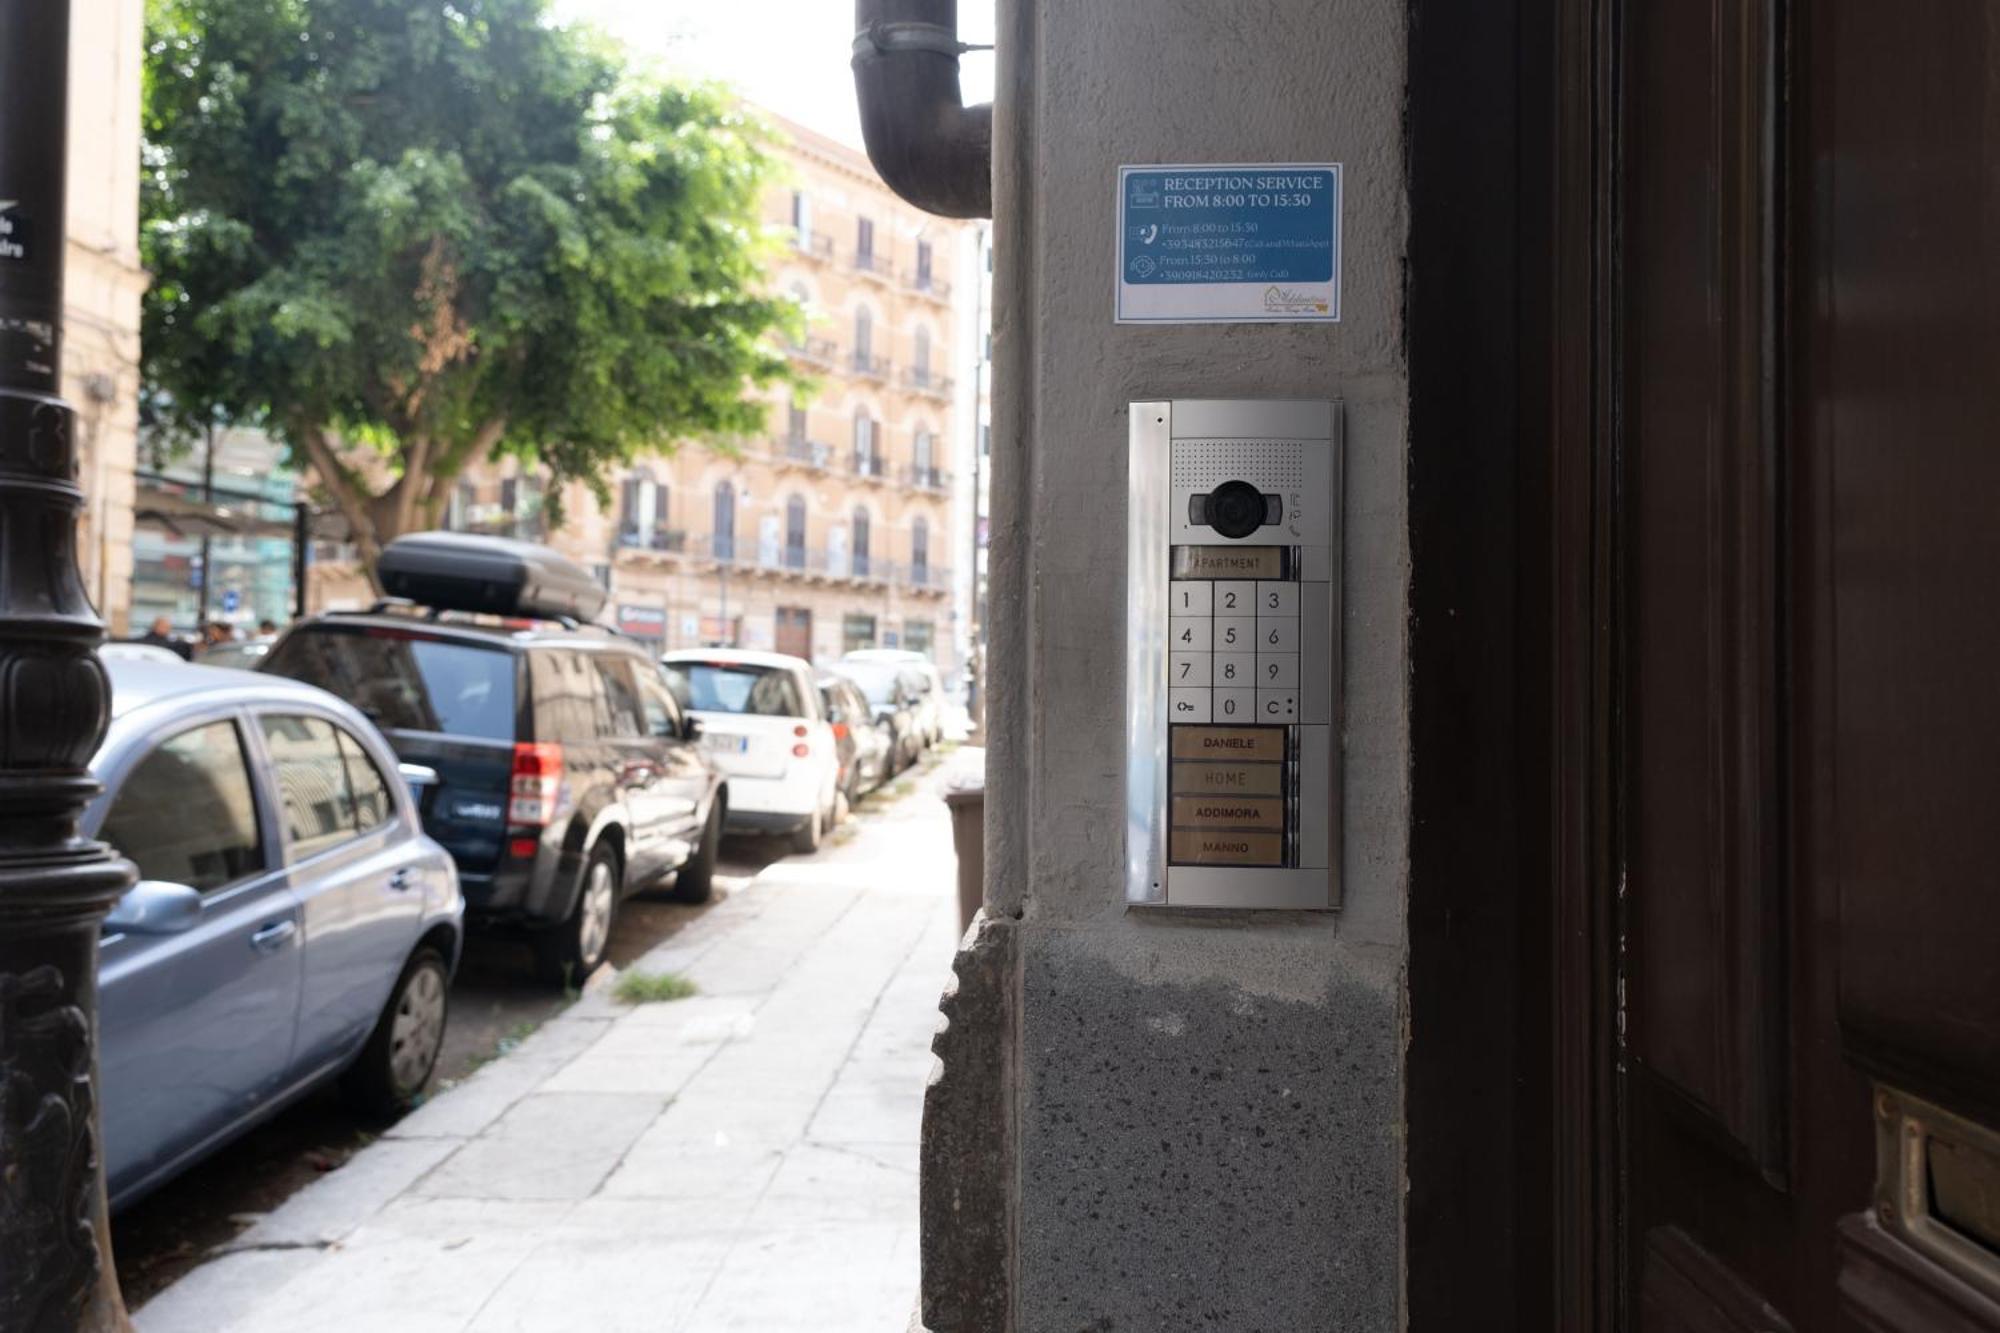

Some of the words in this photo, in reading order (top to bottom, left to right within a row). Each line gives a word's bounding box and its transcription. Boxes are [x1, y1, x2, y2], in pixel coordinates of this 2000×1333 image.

[1164, 176, 1254, 191] RECEPTION
[1257, 176, 1323, 190] SERVICE
[1164, 195, 1209, 209] FROM
[1212, 194, 1245, 208] 8:00
[1247, 194, 1271, 208] TO
[1274, 193, 1312, 208] 15:30
[1162, 223, 1191, 234] From
[1192, 223, 1216, 234] 8:00
[1217, 224, 1229, 233] to
[1231, 222, 1258, 233] 15:30
[1160, 255, 1189, 265] From
[1191, 254, 1218, 265] 15:30
[1219, 255, 1230, 265] to
[1232, 254, 1256, 265] 8:00
[1193, 557, 1260, 570] APARTMENT
[1183, 592, 1190, 608] 1
[1225, 592, 1236, 608] 2
[1268, 592, 1279, 608] 3
[1181, 628, 1192, 643] 4
[1225, 628, 1236, 644] 5
[1269, 628, 1279, 644] 6
[1181, 663, 1191, 679] 7
[1224, 663, 1235, 679] 8
[1269, 663, 1279, 679] 9
[1224, 699, 1235, 715] 0
[1267, 700, 1279, 715] C
[1203, 737, 1255, 749] DANIELE
[1205, 772, 1247, 786] HOME
[1195, 808, 1260, 819] ADDIMORA
[1203, 841, 1249, 853] MANNO
